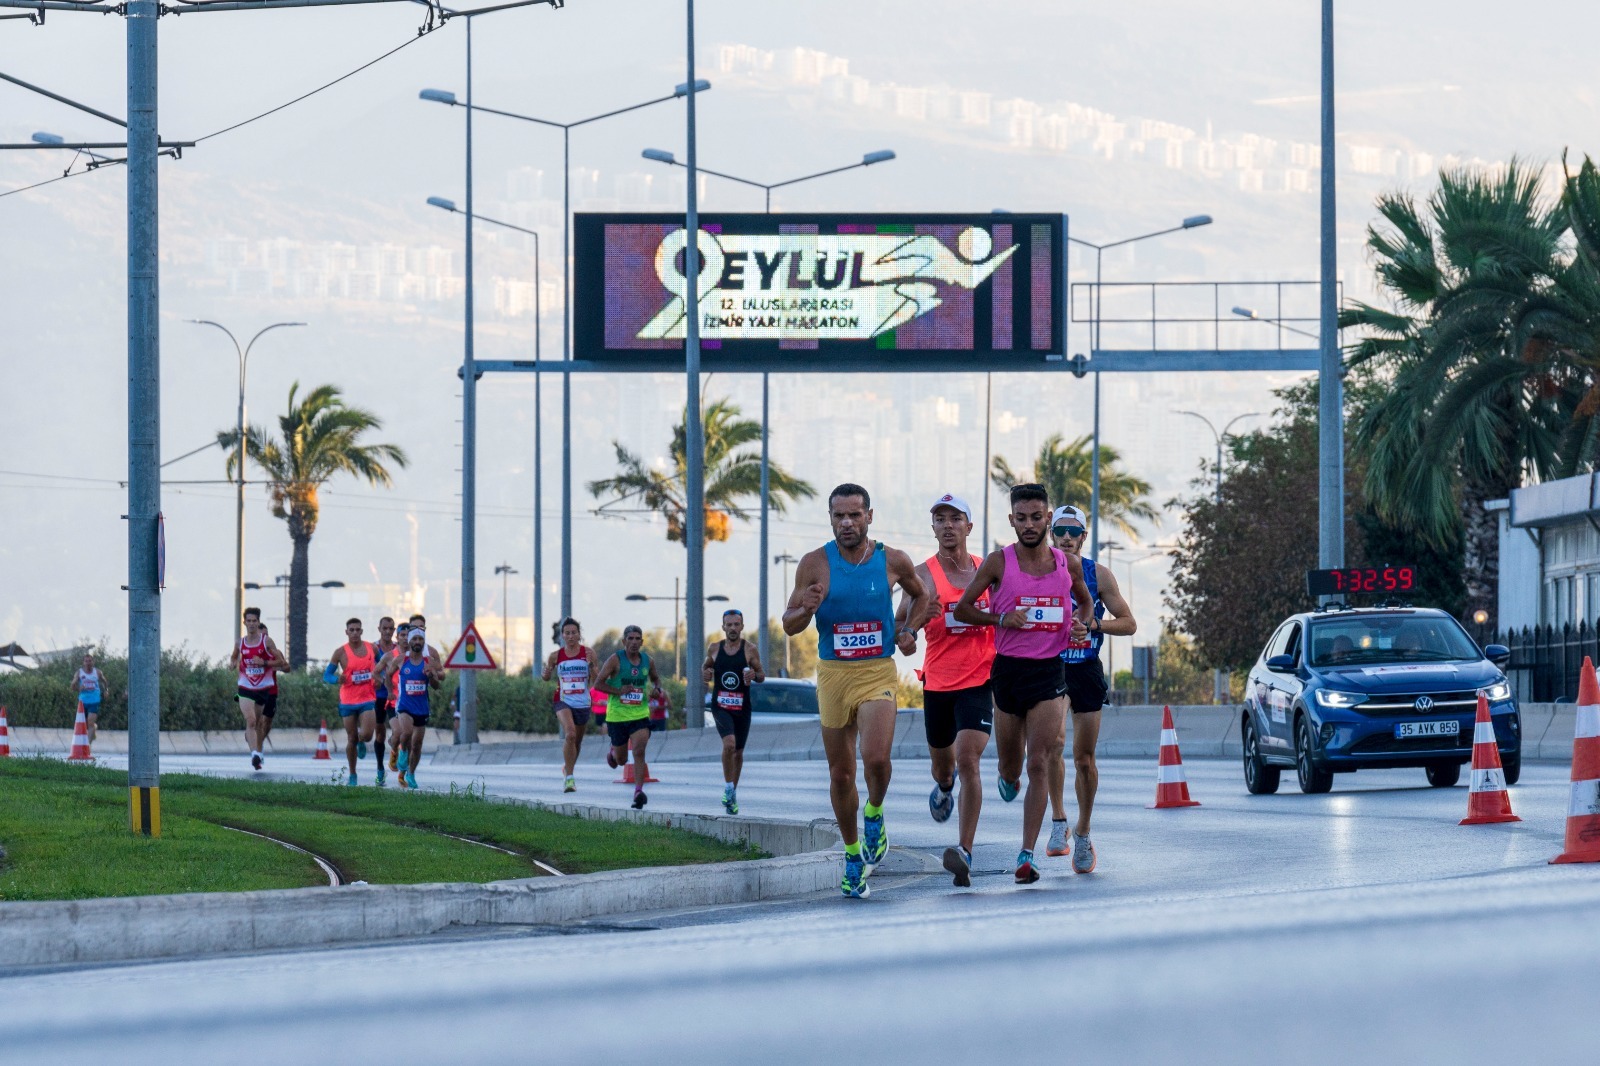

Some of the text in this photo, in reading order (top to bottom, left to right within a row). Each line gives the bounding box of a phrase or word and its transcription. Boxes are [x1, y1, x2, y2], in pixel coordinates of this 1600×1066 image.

[1034, 609, 1044, 620] 8
[840, 634, 876, 647] 3286
[721, 697, 740, 705] 2635
[1401, 721, 1458, 735] 35 AVK 859
